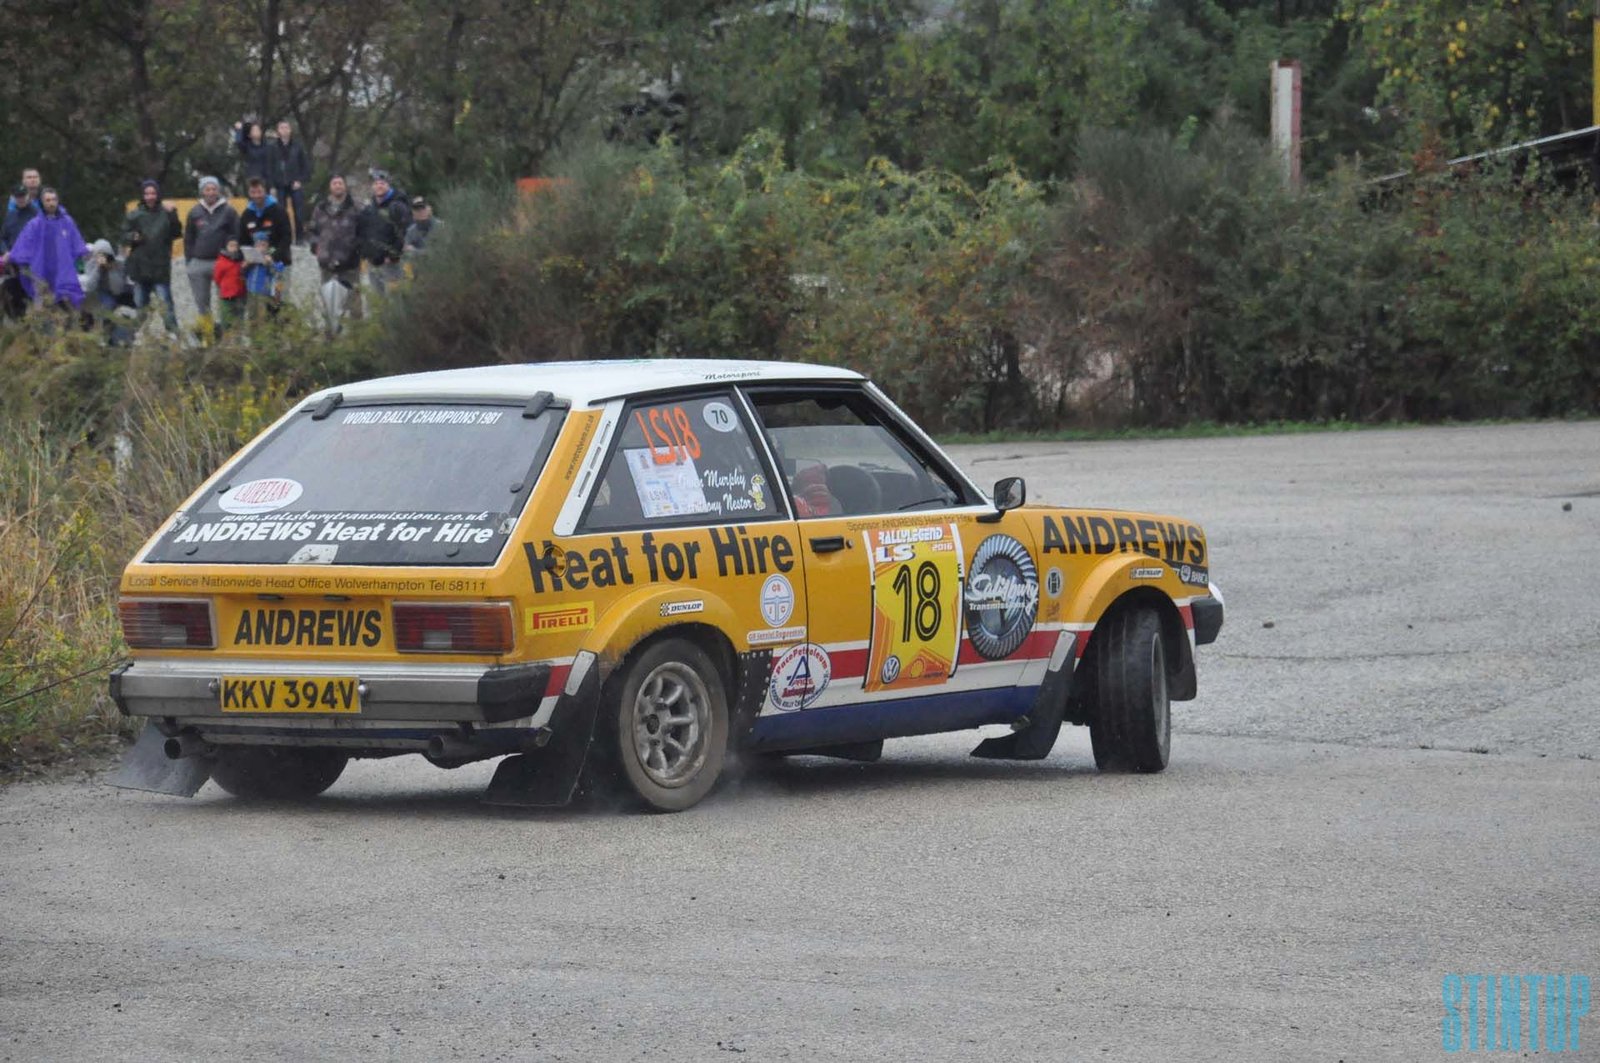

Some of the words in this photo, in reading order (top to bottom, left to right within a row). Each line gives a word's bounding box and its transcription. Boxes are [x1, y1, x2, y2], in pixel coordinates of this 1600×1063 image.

[342, 411, 383, 425] WORLD
[379, 410, 414, 425] RALLY
[412, 410, 480, 425] CHAMPIONS
[711, 409, 728, 424] 70
[704, 468, 747, 491] Murphy
[723, 493, 752, 511] Nestor
[220, 510, 489, 523] www.salisburytransmissions.co.uk
[173, 522, 314, 544] ANDREWS
[317, 522, 381, 543] Heat
[386, 522, 432, 543] for
[433, 523, 494, 544] Hire
[1043, 516, 1206, 565] ANDREWS
[522, 536, 634, 593] Heat
[641, 532, 701, 583] for
[708, 525, 795, 578] Hire
[876, 545, 916, 562] LS
[129, 577, 157, 587] Local
[160, 576, 198, 588] Service
[202, 577, 262, 588] Nationwide
[265, 577, 295, 588] Head
[298, 577, 331, 589] Office
[334, 578, 425, 592] Wolverhampton
[429, 579, 445, 591] Tel
[449, 580, 487, 591] 58111
[671, 603, 702, 612] DUNLOP
[893, 560, 941, 643] 18
[234, 609, 382, 647] ANDREWS
[533, 608, 588, 630] PIRELLI
[223, 680, 276, 708] KKV
[283, 680, 355, 710] 394V
